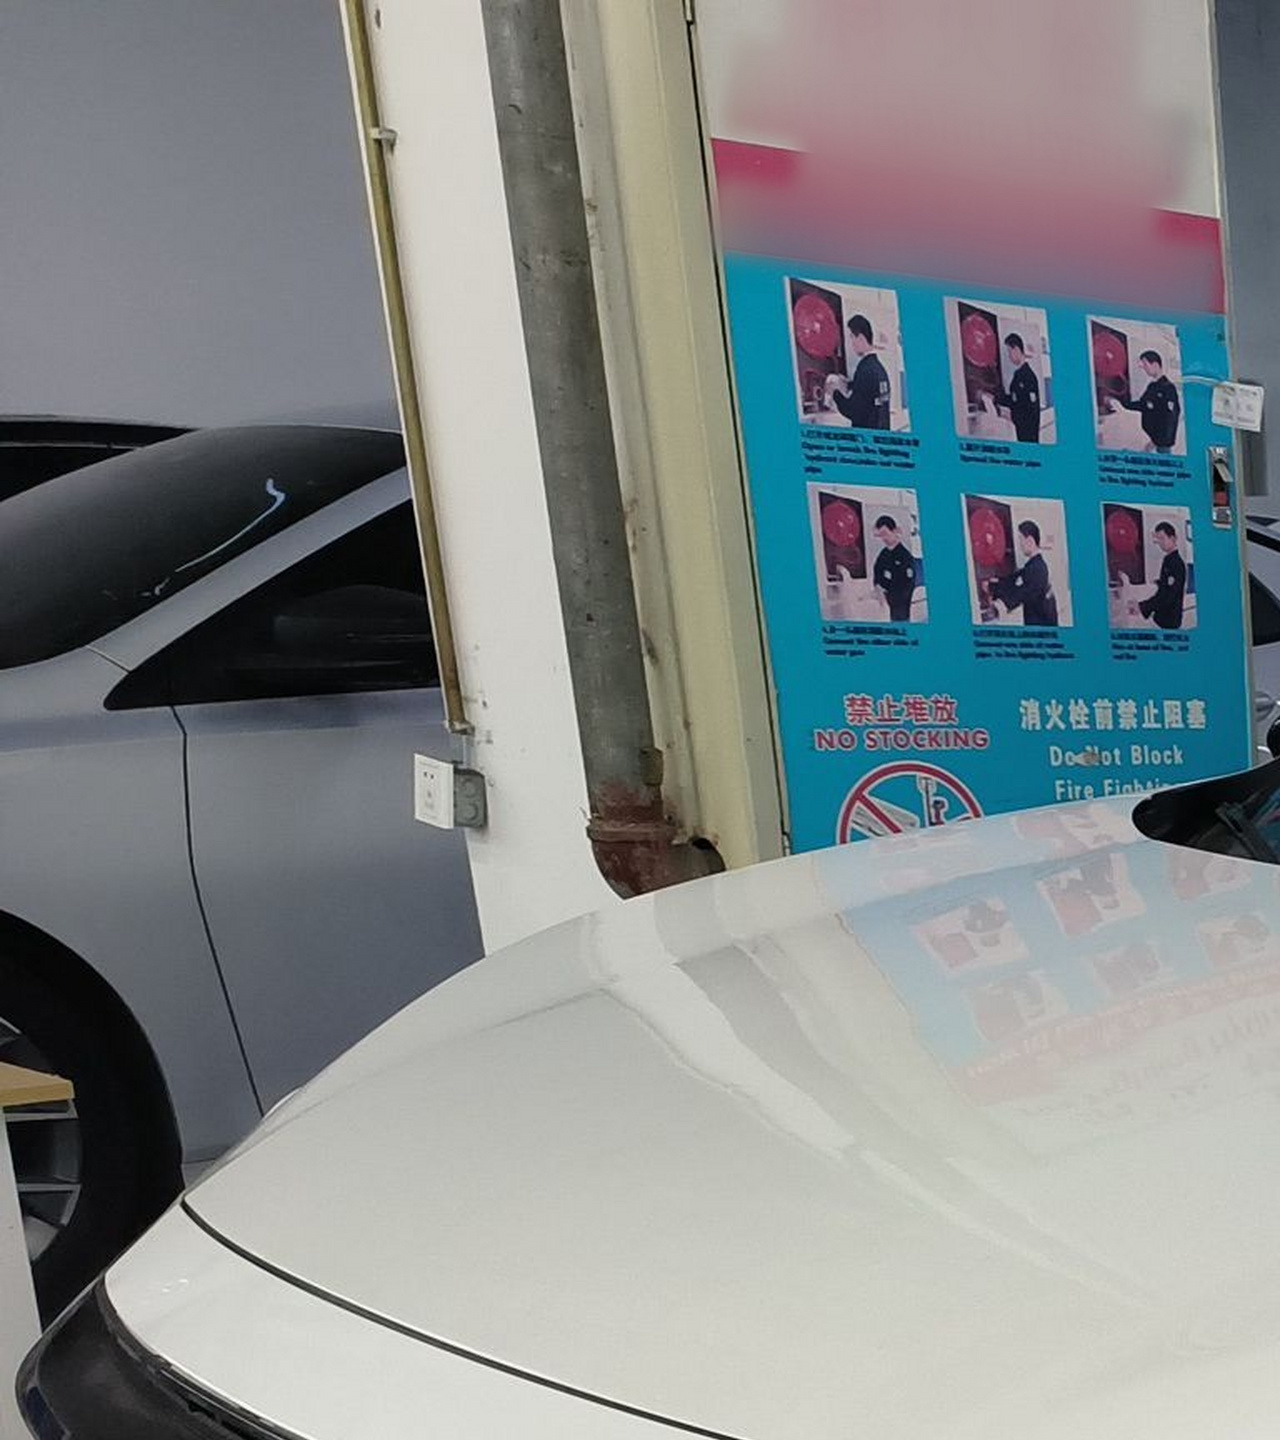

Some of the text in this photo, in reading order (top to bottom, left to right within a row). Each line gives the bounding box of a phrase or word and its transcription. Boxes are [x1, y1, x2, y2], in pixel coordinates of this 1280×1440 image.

[844, 694, 958, 726] 禁止堆放
[1019, 697, 1207, 731] 消火栓前禁止阻塞
[814, 728, 990, 751] NO STOCKING
[1131, 745, 1183, 766] Block
[1055, 780, 1094, 801] Fire
